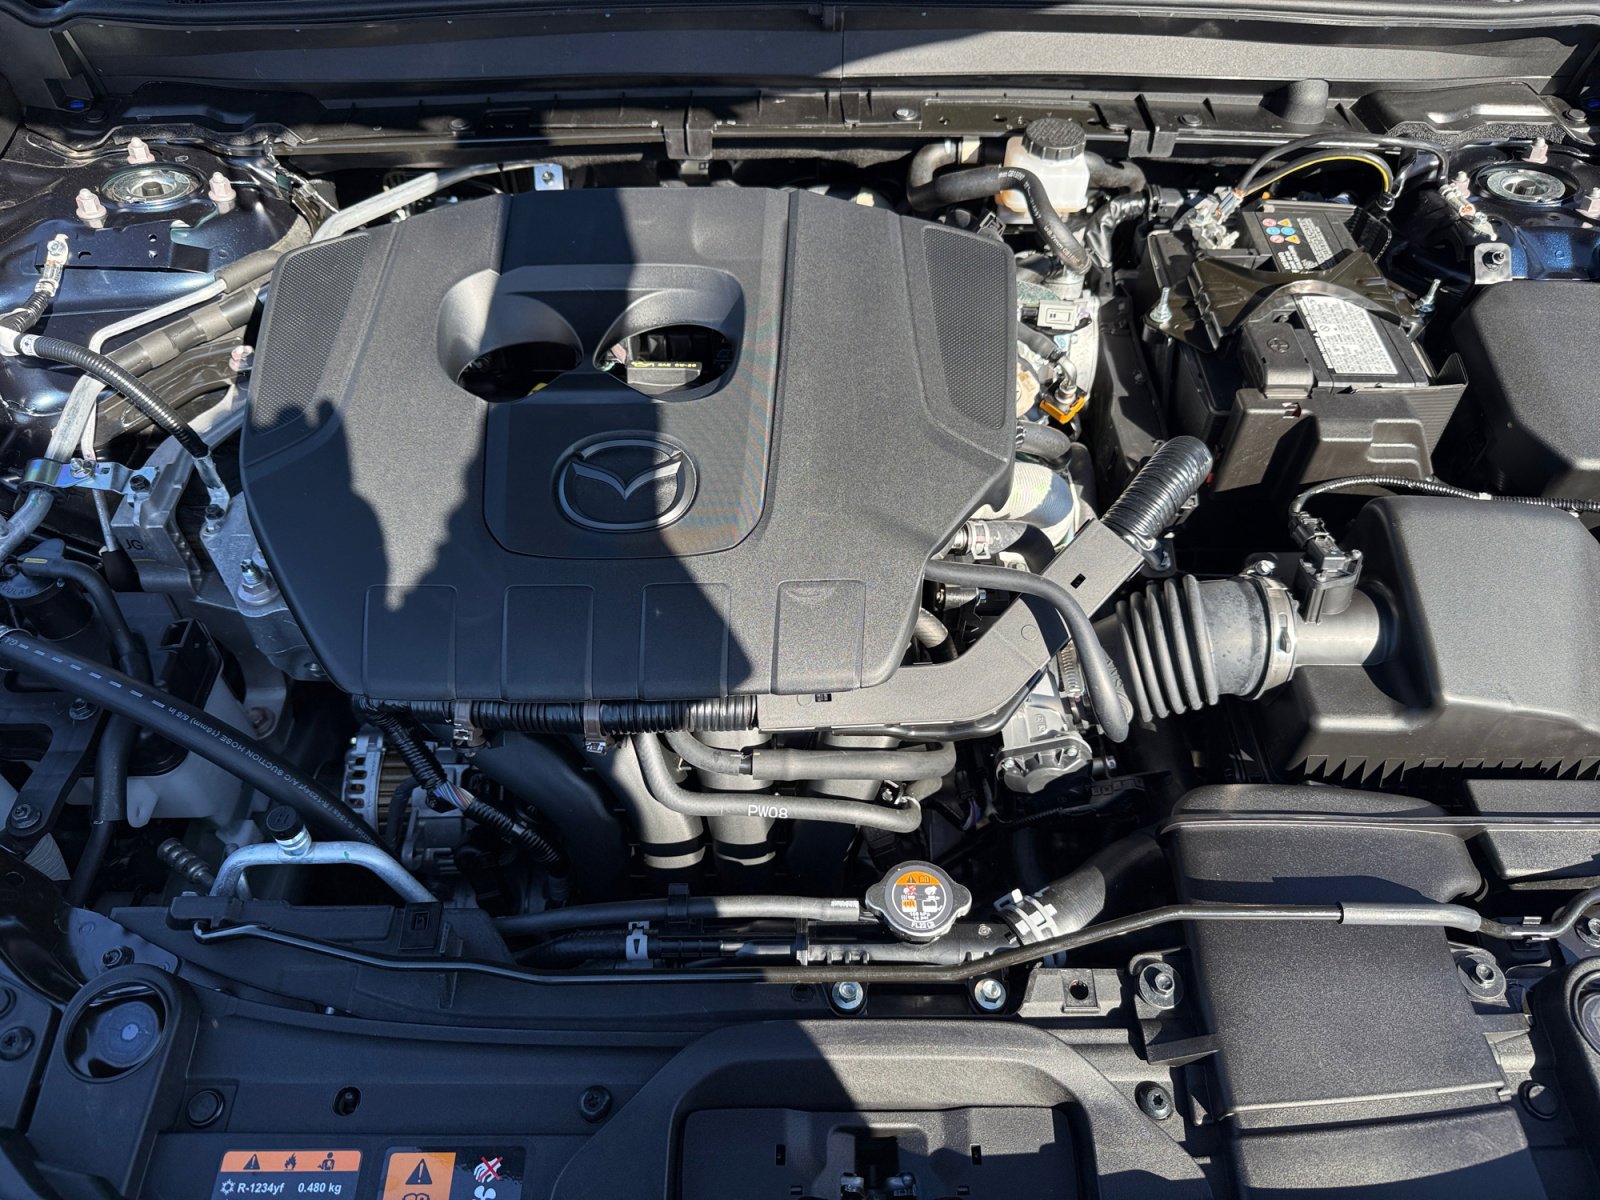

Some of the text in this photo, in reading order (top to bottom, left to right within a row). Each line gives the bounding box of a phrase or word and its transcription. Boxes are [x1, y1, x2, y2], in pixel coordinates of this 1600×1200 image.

[126, 539, 144, 550] JG
[190, 717, 220, 737] (16mm)
[220, 734, 246, 752] HOSE
[245, 750, 284, 776] SUCTION
[284, 774, 299, 786] A/C
[747, 804, 788, 819] PW08
[237, 1182, 342, 1195] R-1234yf 0.480 kg
